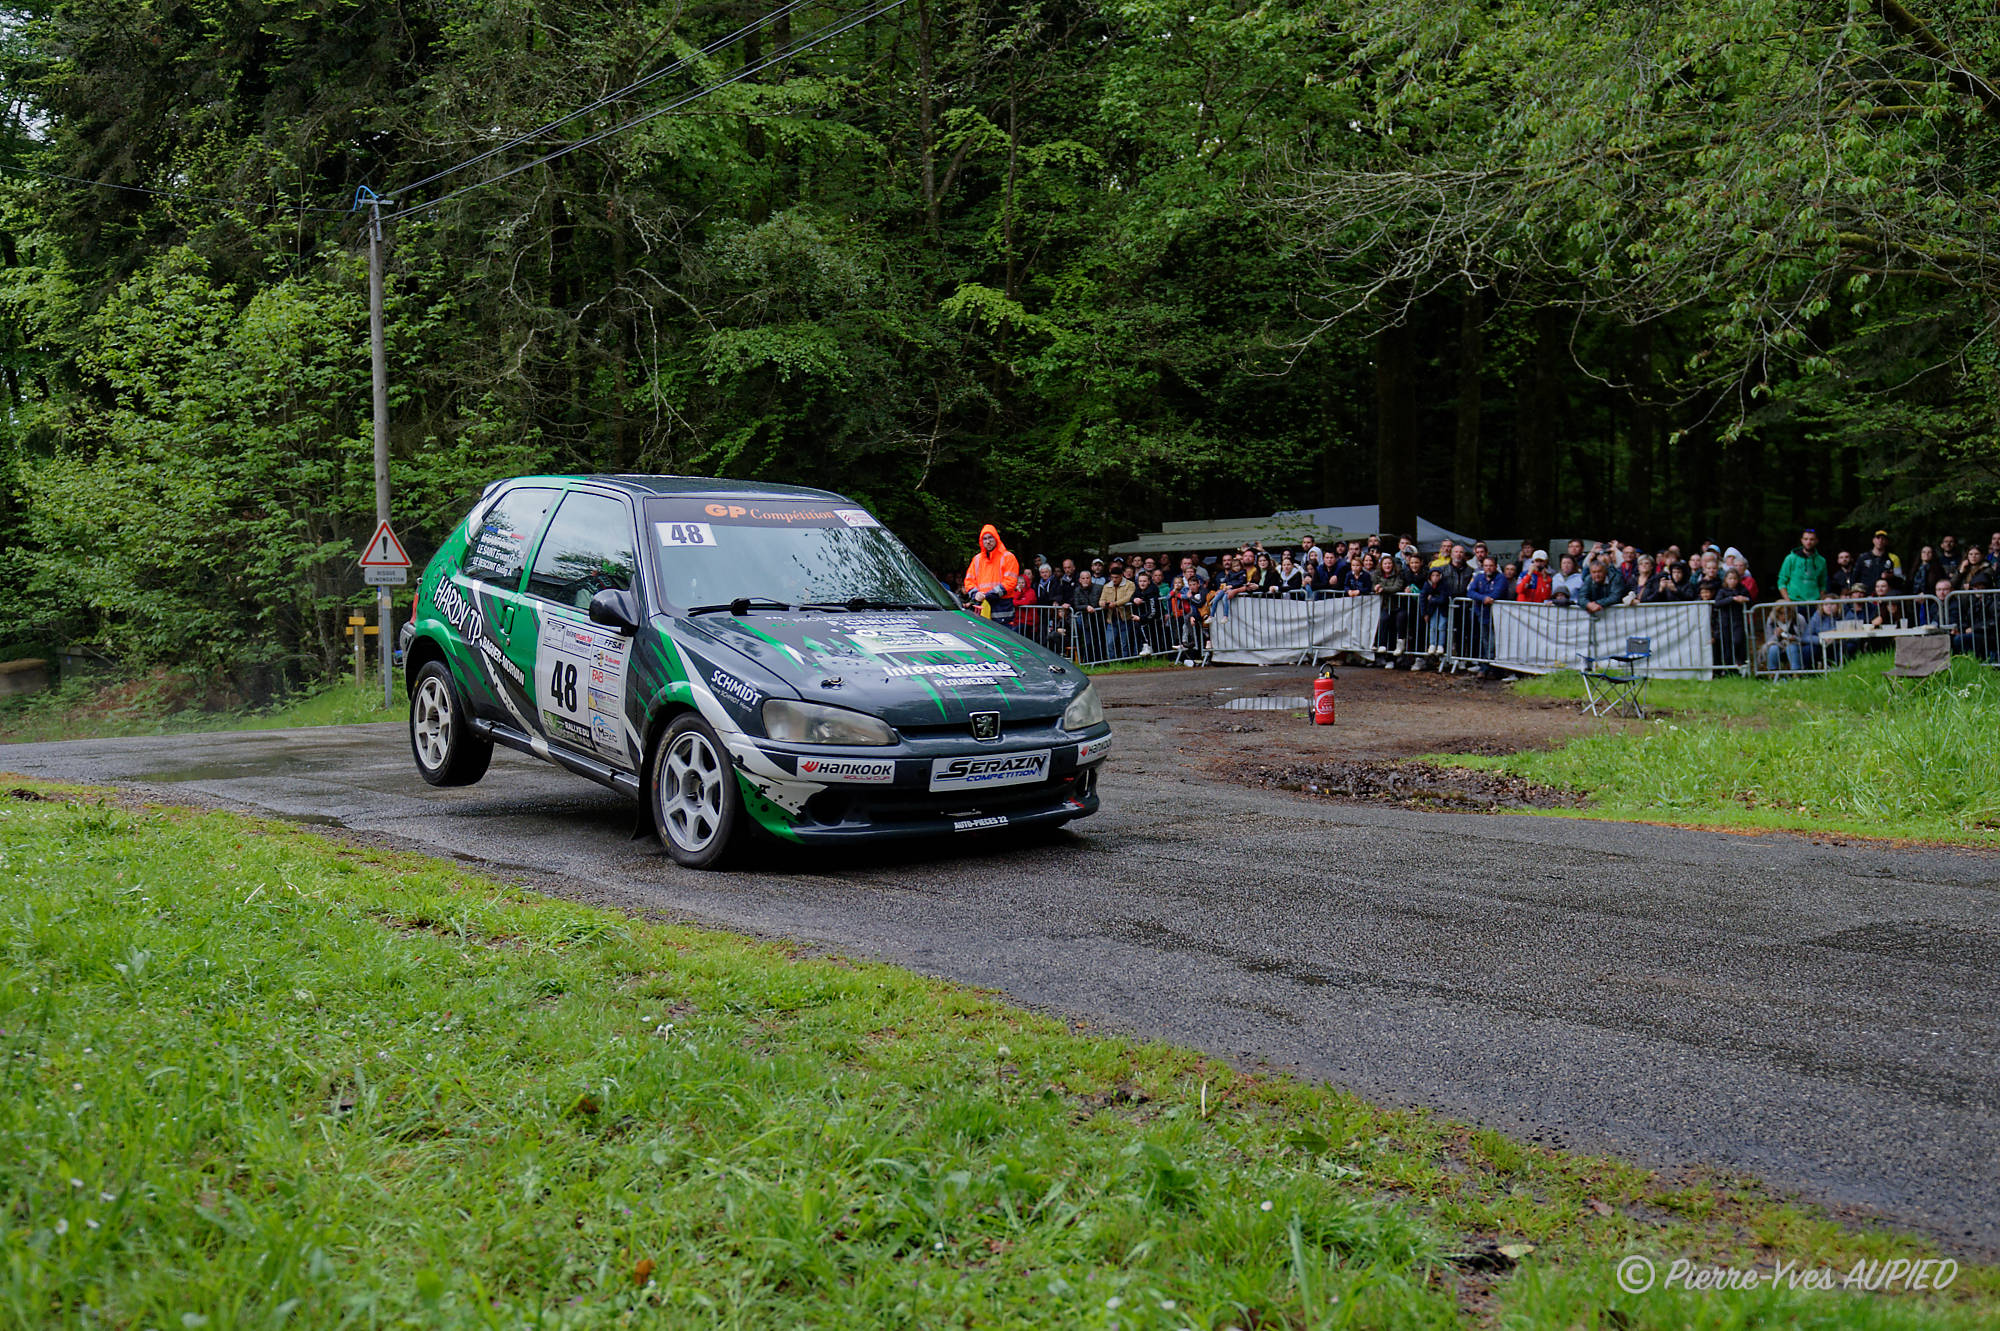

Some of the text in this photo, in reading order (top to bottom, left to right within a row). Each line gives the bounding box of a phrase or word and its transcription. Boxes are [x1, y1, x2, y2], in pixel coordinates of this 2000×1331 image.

[705, 503, 747, 519] GP
[749, 507, 835, 523] Compétition
[671, 524, 704, 544] 48
[433, 575, 483, 646] HARDY TP
[882, 661, 1014, 677] Intermarché
[551, 660, 577, 713] 48
[711, 669, 763, 706] SCHMIDT
[934, 677, 998, 687] PLOUBEZRE
[936, 755, 1047, 779] SERAZIN
[966, 770, 1036, 782] COMPETITION
